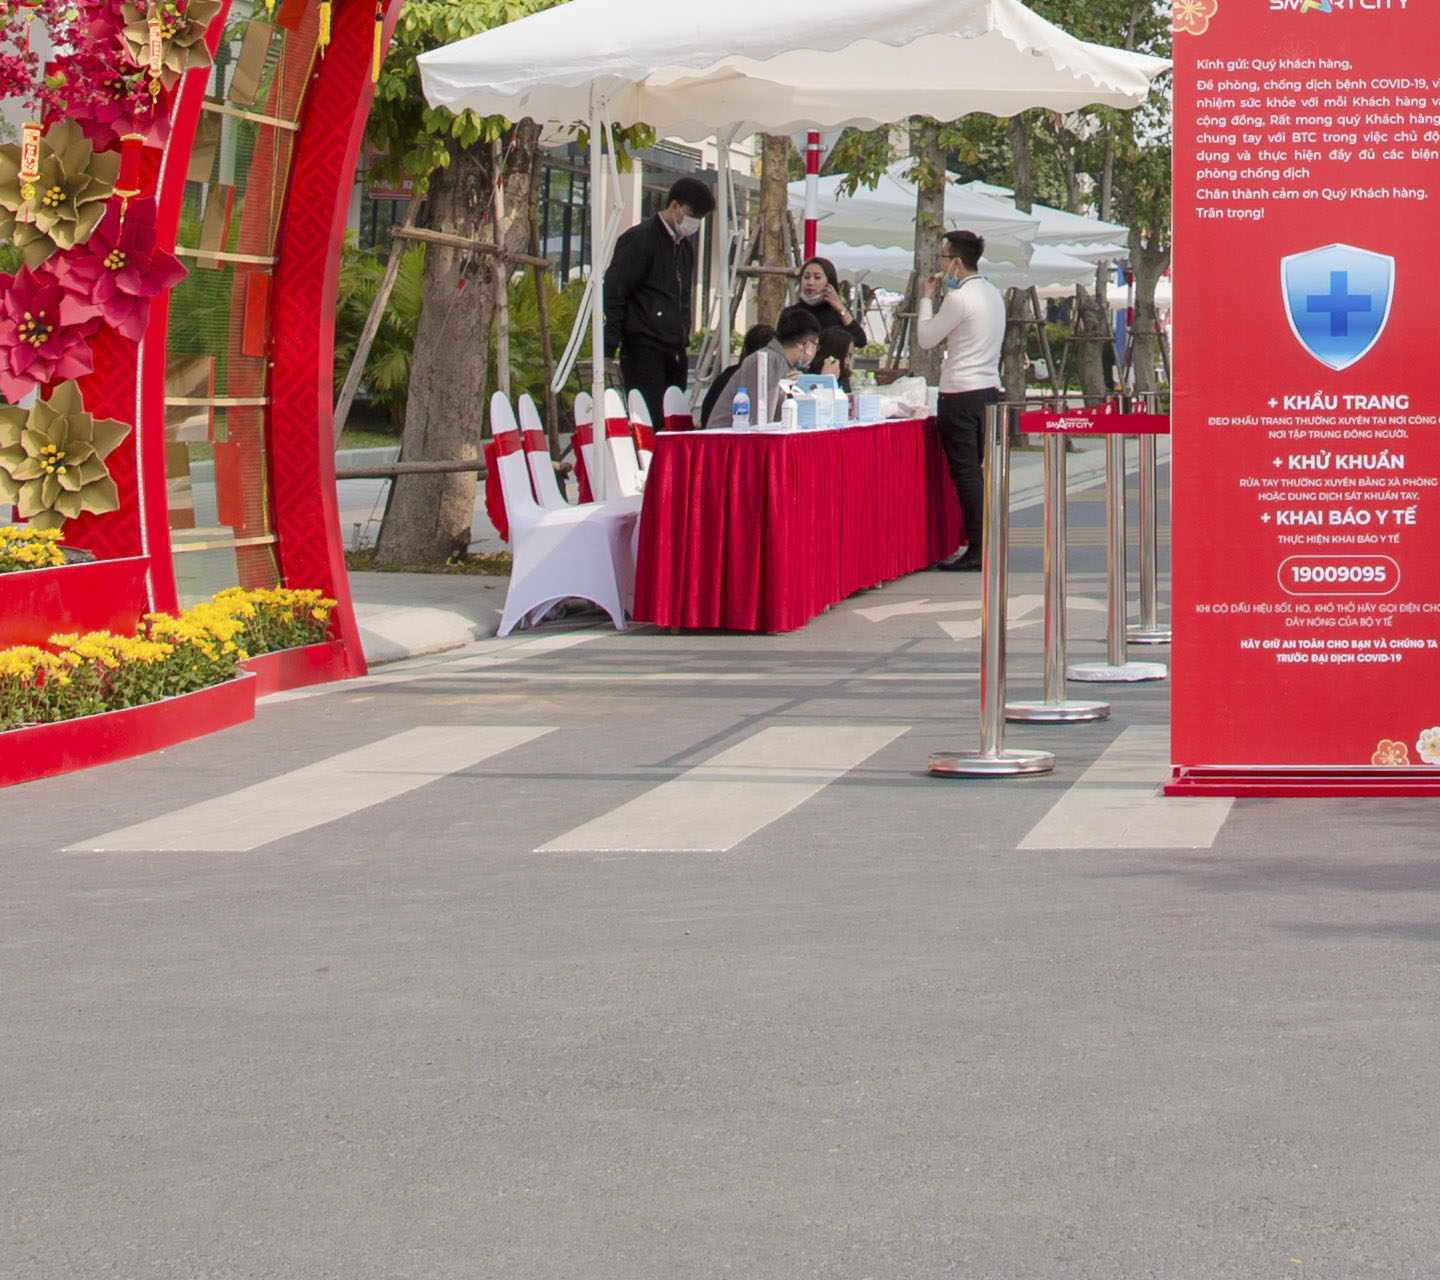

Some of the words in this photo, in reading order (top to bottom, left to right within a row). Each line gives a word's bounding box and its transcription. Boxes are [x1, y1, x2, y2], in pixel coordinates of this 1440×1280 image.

[1197, 59, 1224, 69] Kính
[1251, 59, 1276, 71] Quý
[1279, 58, 1316, 69] khách
[1263, 78, 1302, 92] chống
[1305, 79, 1332, 92] dịch
[1336, 78, 1367, 91] bệnh
[1371, 78, 1429, 90] COVID-19,
[1197, 97, 1235, 110] nhiệm
[1240, 97, 1261, 108] sức
[1266, 96, 1296, 108] khỏe
[1301, 96, 1318, 107] với
[1353, 96, 1390, 107] Khách
[1396, 96, 1426, 108] hàng
[1196, 115, 1226, 128] cộng
[1295, 116, 1332, 127] mong
[1337, 114, 1361, 127] quý
[1365, 113, 1404, 124] Khách
[1409, 113, 1440, 126] hàng
[1196, 132, 1236, 145] chung
[1242, 133, 1262, 145] tay
[1267, 132, 1285, 143] với
[1292, 132, 1317, 143] BTC
[1322, 133, 1357, 144] trong
[1363, 131, 1388, 144] việc
[1393, 130, 1417, 142] chủ
[1196, 150, 1230, 163] dụng
[1237, 150, 1251, 160] và
[1258, 149, 1287, 163] thực
[1294, 149, 1321, 162] hiện
[1358, 148, 1375, 160] đủ
[1383, 149, 1404, 160] các
[1411, 148, 1439, 161] biện
[1196, 168, 1237, 181] phòng
[1240, 167, 1280, 181] chống
[1283, 167, 1310, 180] dịch
[1196, 188, 1229, 199] Chân
[1232, 188, 1269, 199] thành
[1321, 188, 1348, 201] Quý
[1350, 187, 1389, 198] Khách
[1392, 187, 1428, 200] hàng.
[1196, 207, 1223, 218] Trân
[1226, 207, 1264, 220] trọng!
[1284, 390, 1338, 410] KHẨU
[1342, 395, 1409, 410] TRANG
[1289, 450, 1331, 469] KHỬ
[1335, 449, 1404, 469] KHUẨN
[1277, 510, 1323, 525] KHAI
[1329, 507, 1371, 525] BÁO
[1375, 510, 1389, 524] Y
[1392, 505, 1417, 524] TẾ
[1292, 566, 1386, 582] 19009095
